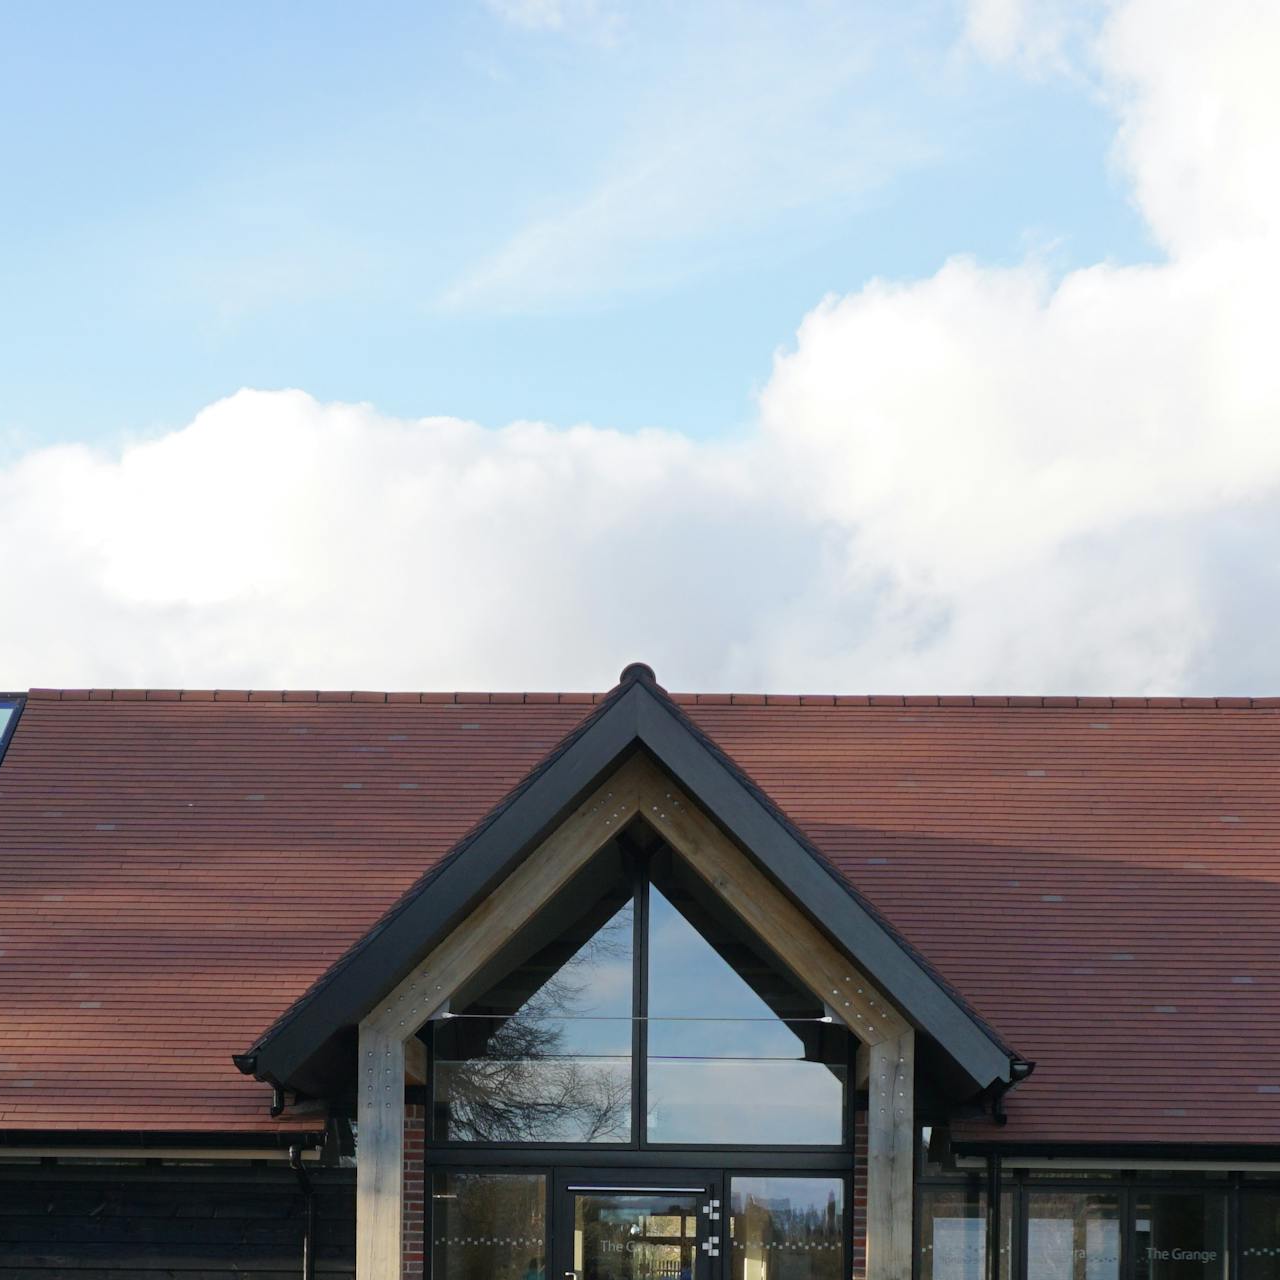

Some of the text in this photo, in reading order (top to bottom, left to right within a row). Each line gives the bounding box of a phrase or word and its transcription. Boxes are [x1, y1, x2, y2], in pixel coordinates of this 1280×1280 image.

[600, 1239, 623, 1252] The
[1145, 1247, 1217, 1264] The Grange
